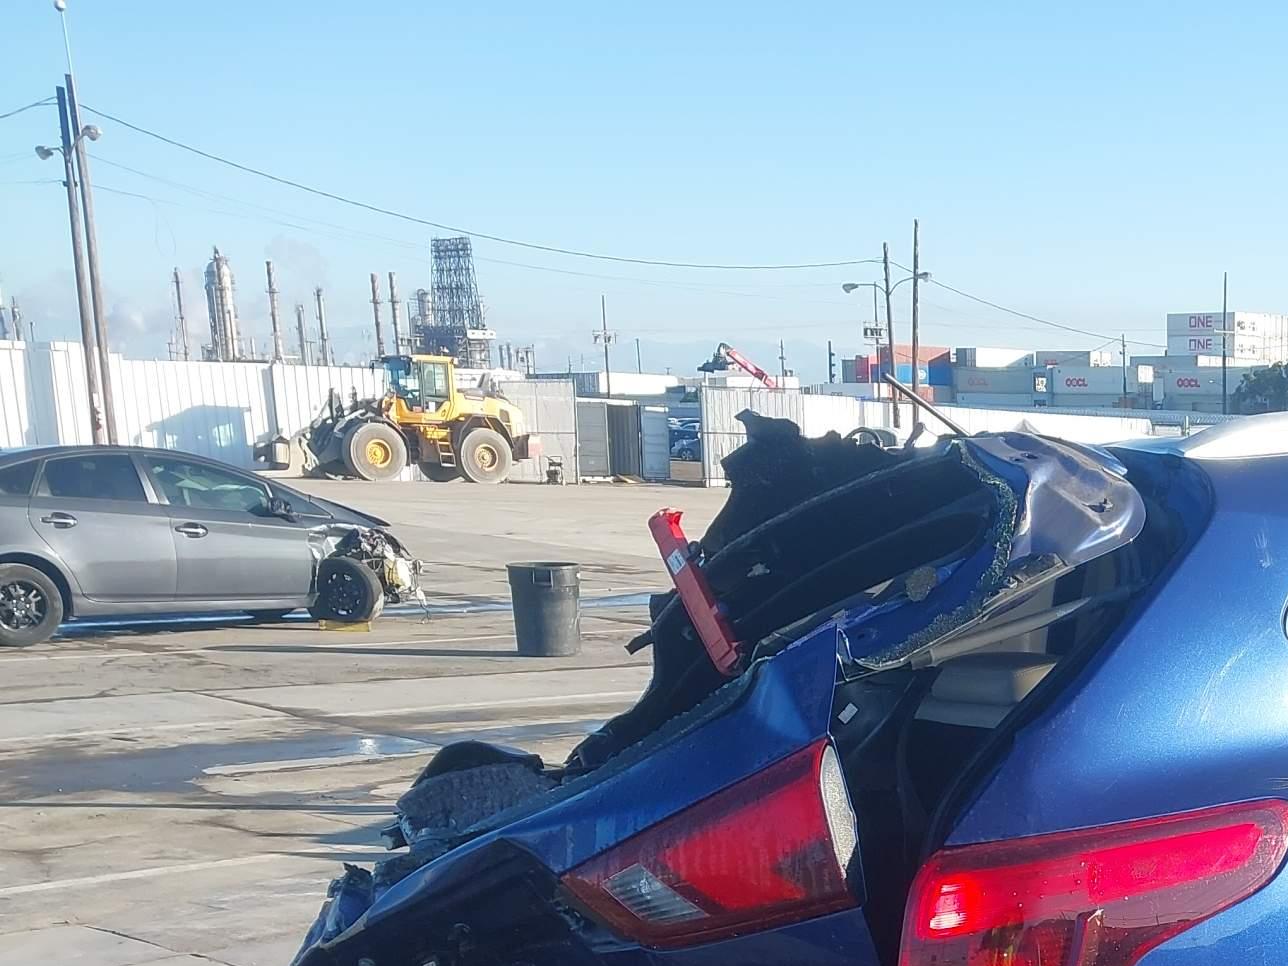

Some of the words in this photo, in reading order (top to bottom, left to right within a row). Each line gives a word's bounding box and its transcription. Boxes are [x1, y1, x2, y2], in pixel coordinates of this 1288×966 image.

[1188, 315, 1213, 329] ONE
[1188, 338, 1213, 352] ONE
[1065, 377, 1089, 388] OOCL
[1176, 377, 1201, 389] OOCL
